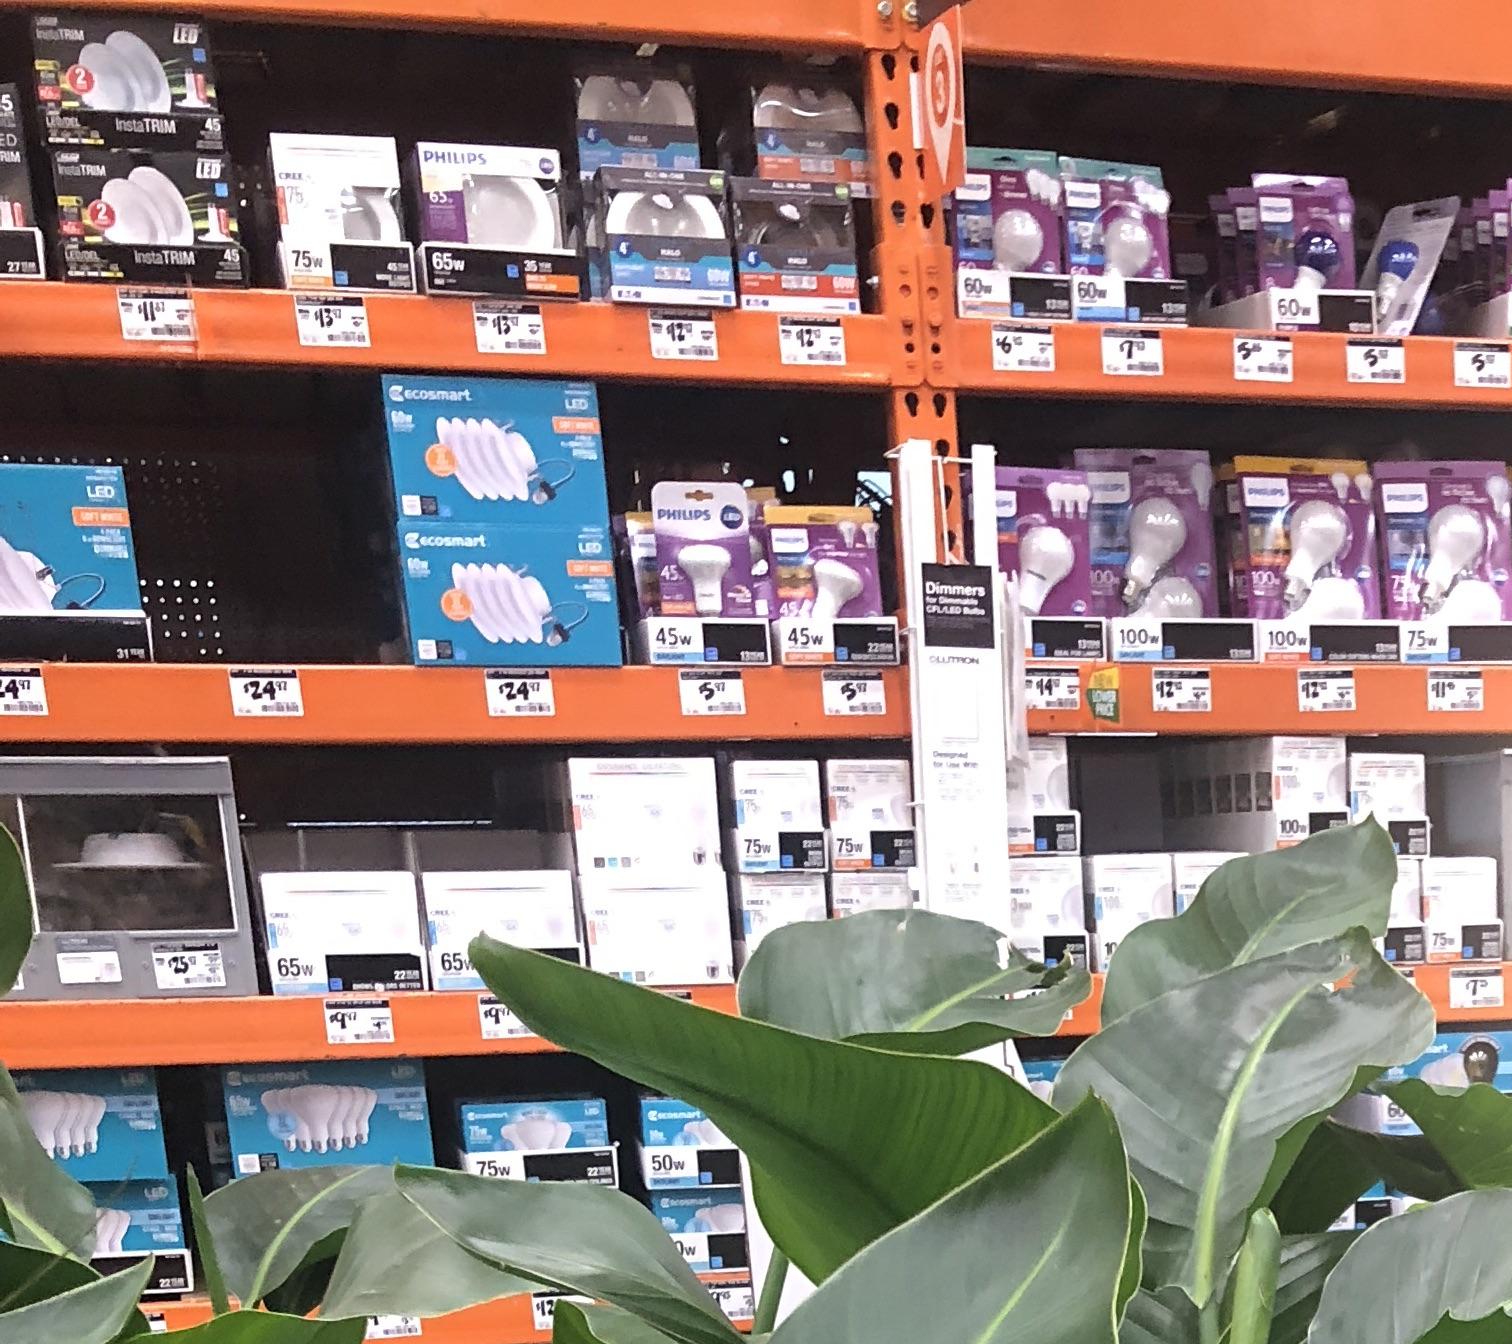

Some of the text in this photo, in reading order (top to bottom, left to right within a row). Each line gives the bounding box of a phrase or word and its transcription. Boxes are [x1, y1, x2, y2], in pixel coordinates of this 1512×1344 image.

[172, 27, 199, 44] LED
[75, 68, 86, 84] 2
[0, 94, 14, 112] 5
[115, 118, 177, 134] InstaTRIM
[205, 118, 221, 132] 45
[423, 150, 487, 166] PHILIPS
[196, 162, 221, 179] LED
[97, 202, 109, 220] 2
[134, 250, 196, 266] InstaTRIM
[223, 250, 240, 264] 45
[7, 262, 20, 274] 27
[404, 388, 472, 401] ecosmart
[564, 398, 589, 411] LED
[86, 485, 115, 499] LED
[656, 508, 712, 522] PHILIPS
[420, 534, 487, 548] ecosmart
[578, 542, 602, 554] LED
[925, 581, 986, 597] Dimmers
[926, 597, 979, 607] for Dimmable
[926, 605, 986, 617] CFL/LED Bulbs
[117, 648, 129, 660] 31
[936, 655, 980, 665] LUTRON
[0, 679, 32, 700] 497
[394, 970, 405, 980] 22
[657, 1110, 702, 1121] ecosmart
[158, 1277, 171, 1288] 22
